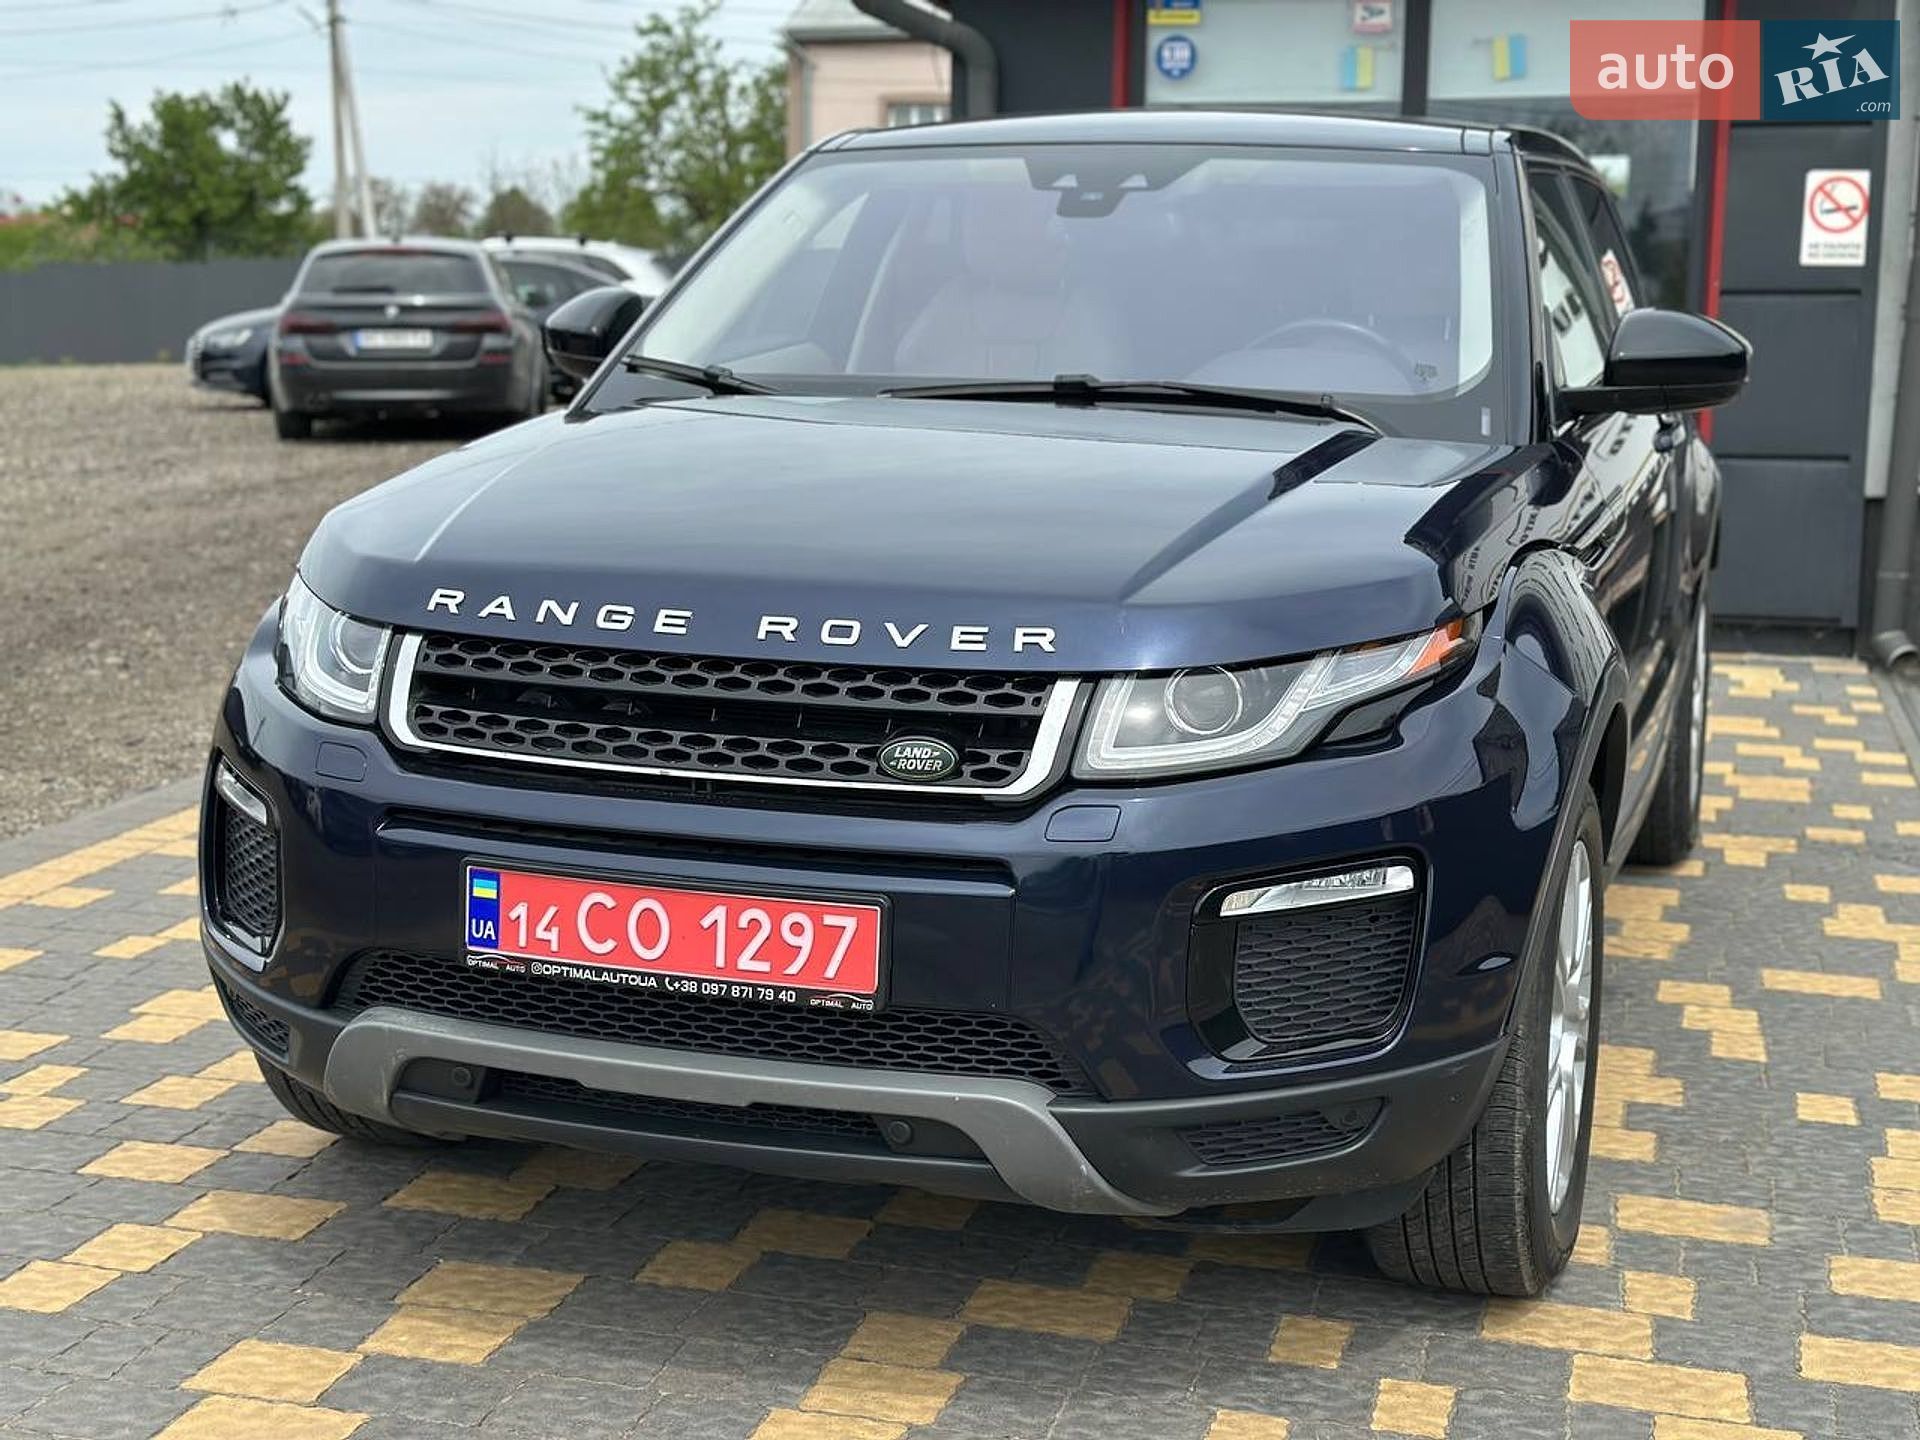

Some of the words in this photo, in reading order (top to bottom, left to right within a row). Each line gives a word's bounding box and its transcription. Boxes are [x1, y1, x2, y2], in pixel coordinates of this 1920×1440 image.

[426, 588, 693, 635] RANGE
[756, 616, 1056, 653] ROVER
[894, 746, 932, 758] LAND
[897, 759, 943, 771] ROVER
[470, 918, 497, 942] UA
[508, 901, 560, 953] 14
[576, 891, 671, 961] CO
[699, 904, 858, 980] 1297
[467, 957, 499, 970] OPTIMAL
[505, 963, 526, 973] AUTO
[701, 982, 727, 996] 097
[731, 985, 753, 998] 871
[757, 988, 774, 1001] 79
[778, 990, 796, 1003] 40
[810, 998, 844, 1009] OPTIMAL
[851, 1001, 873, 1011] AUTO
